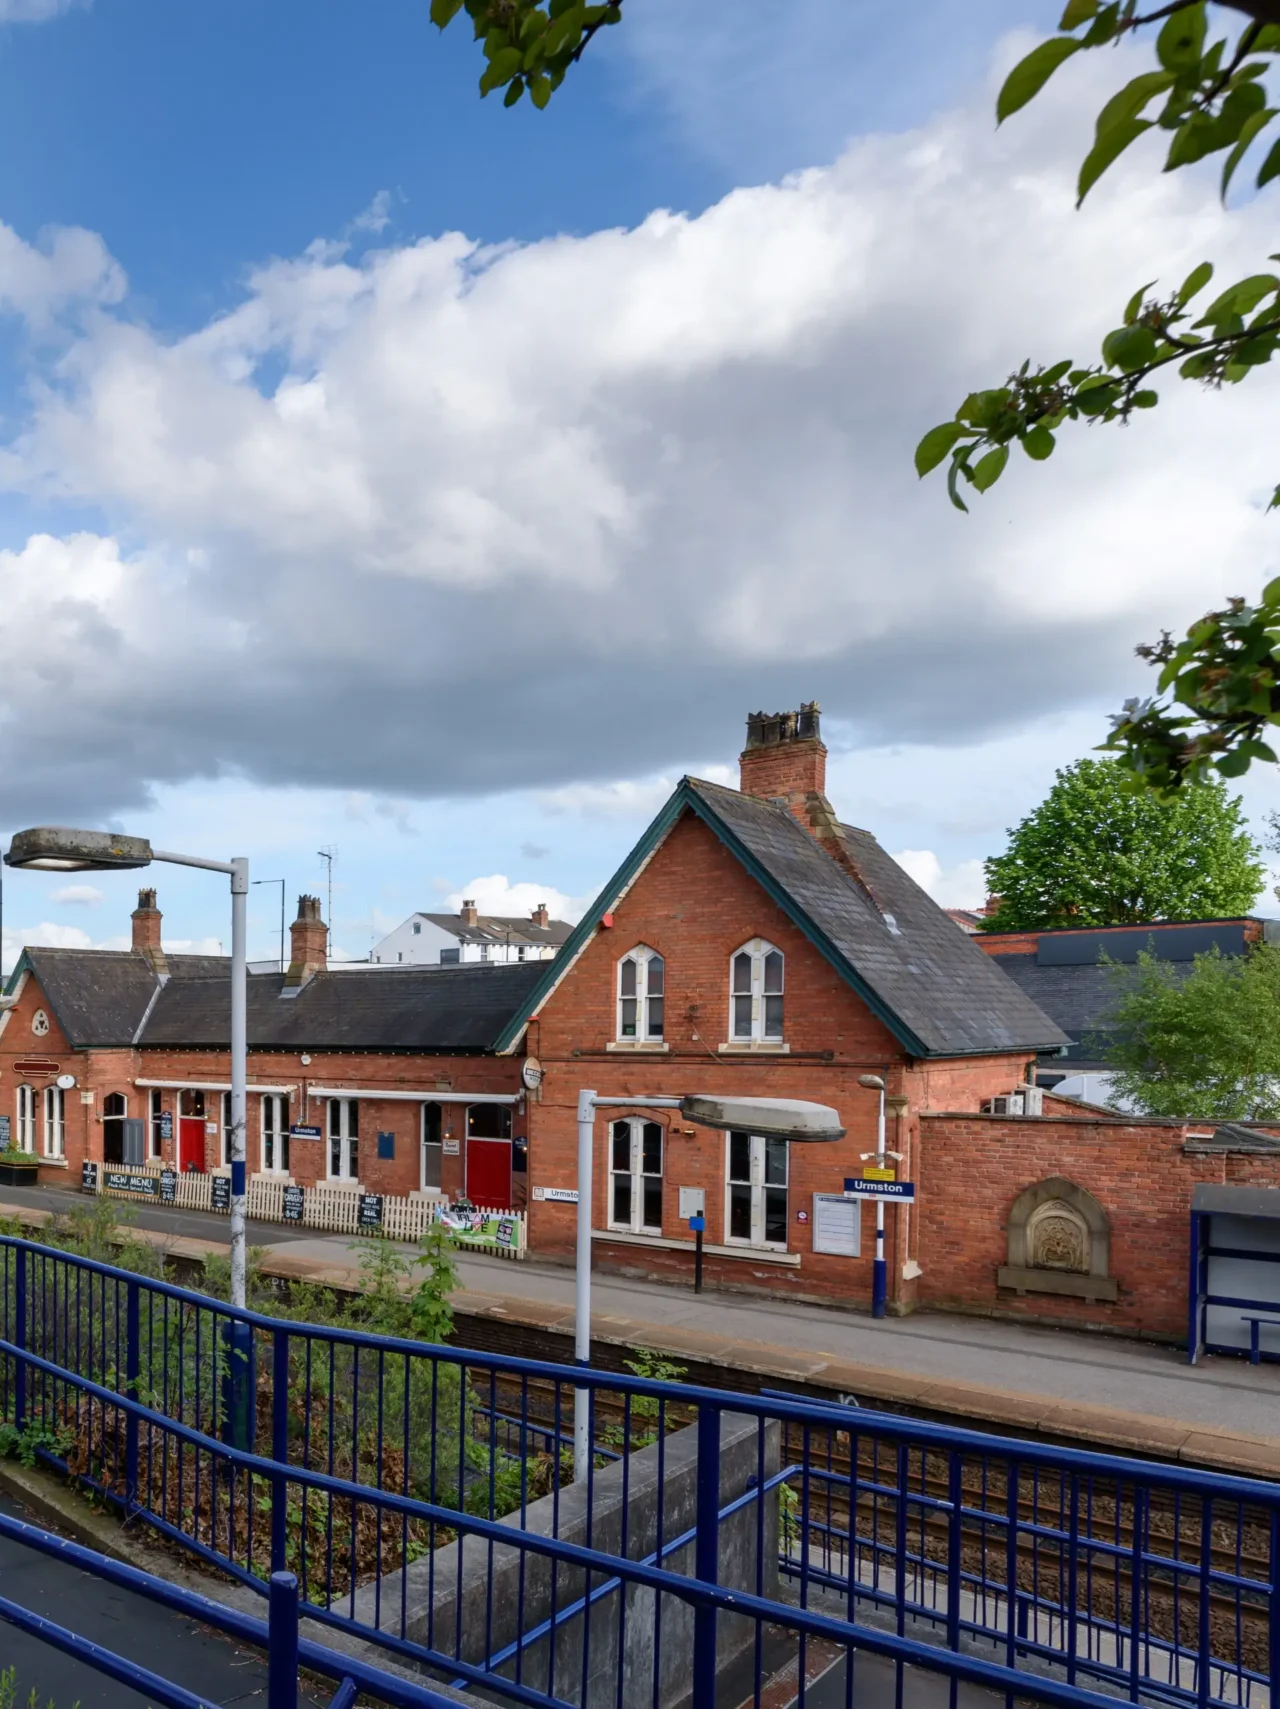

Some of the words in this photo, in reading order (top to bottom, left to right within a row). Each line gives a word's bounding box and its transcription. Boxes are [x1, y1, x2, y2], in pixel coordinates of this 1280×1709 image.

[110, 1174, 127, 1184] NEW
[130, 1176, 153, 1188] MENU
[854, 1181, 903, 1192] Urmston
[551, 1190, 579, 1199] Urmsto
